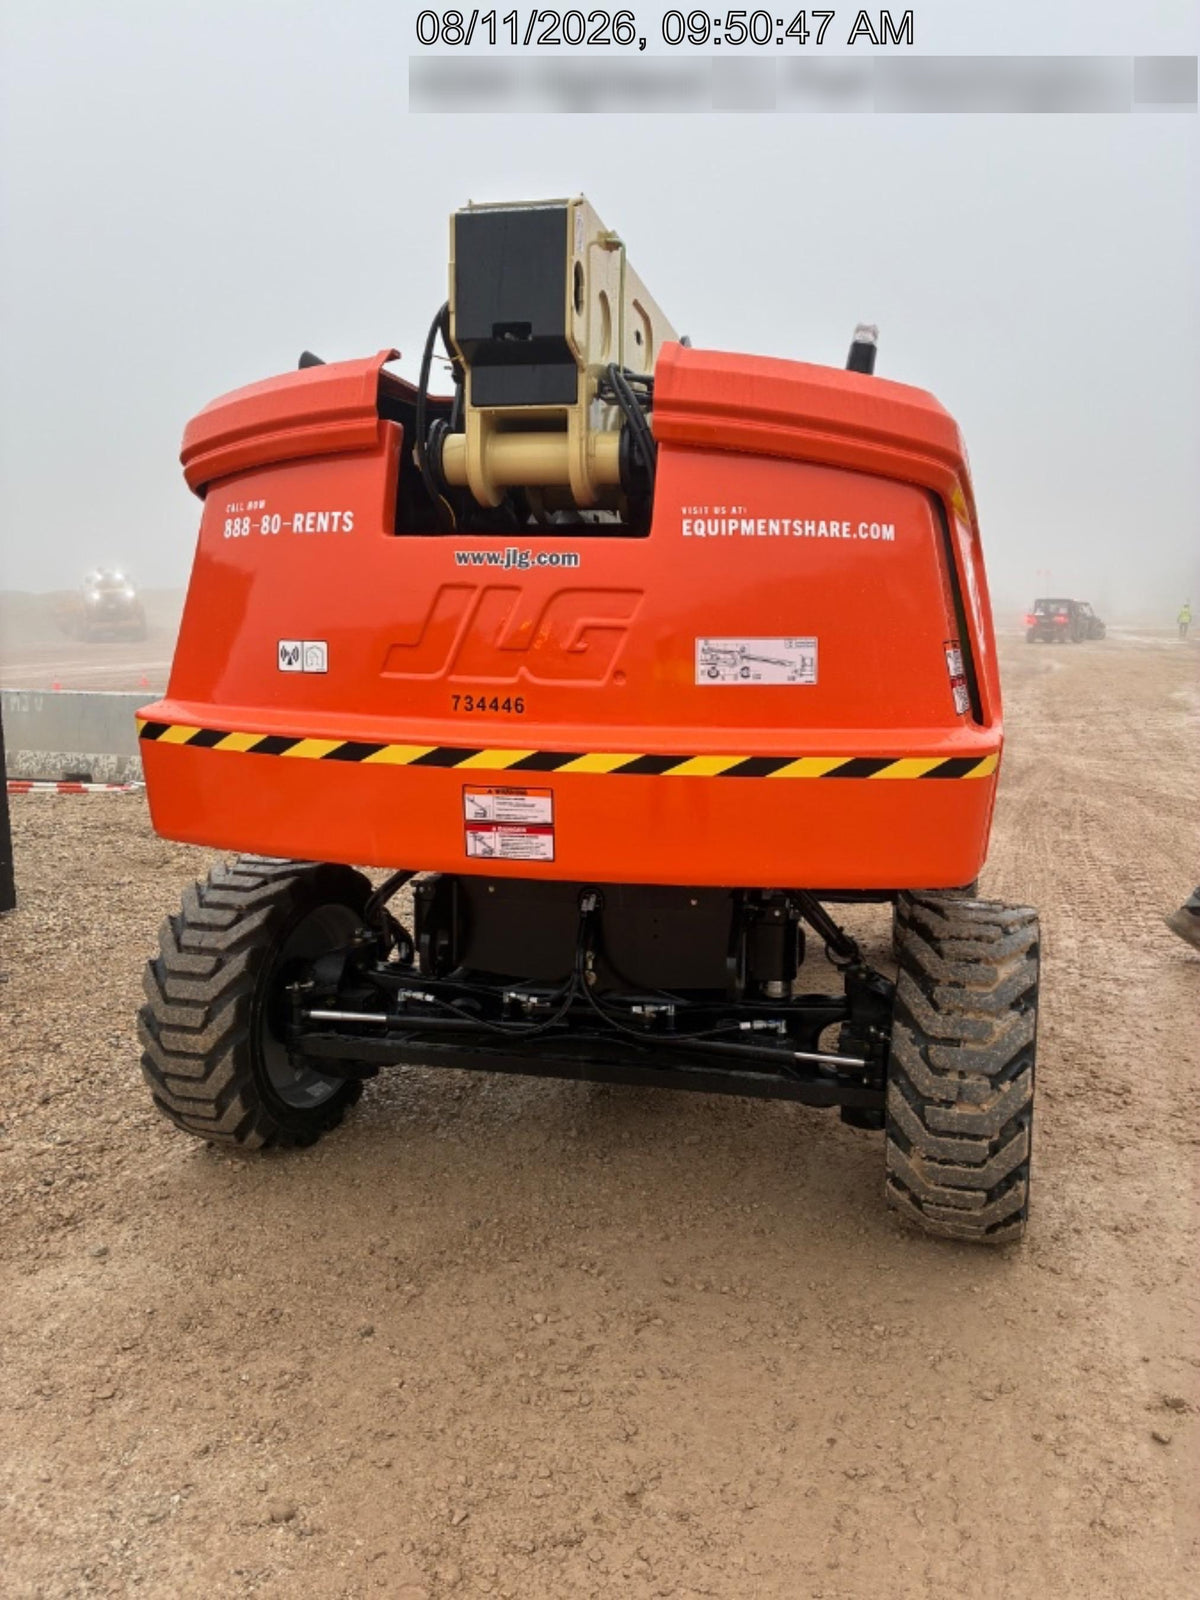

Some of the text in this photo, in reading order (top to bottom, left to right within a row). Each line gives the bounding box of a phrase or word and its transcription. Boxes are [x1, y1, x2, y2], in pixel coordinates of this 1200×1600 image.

[681, 506, 709, 515] VISIT
[713, 506, 727, 515] US
[223, 511, 355, 539] 888-80-RENTS
[681, 518, 896, 542] EQUIPMENTSHARE.COM
[455, 548, 580, 569] www.jlg.com
[379, 582, 645, 688] JLG
[451, 694, 526, 714] 734446
